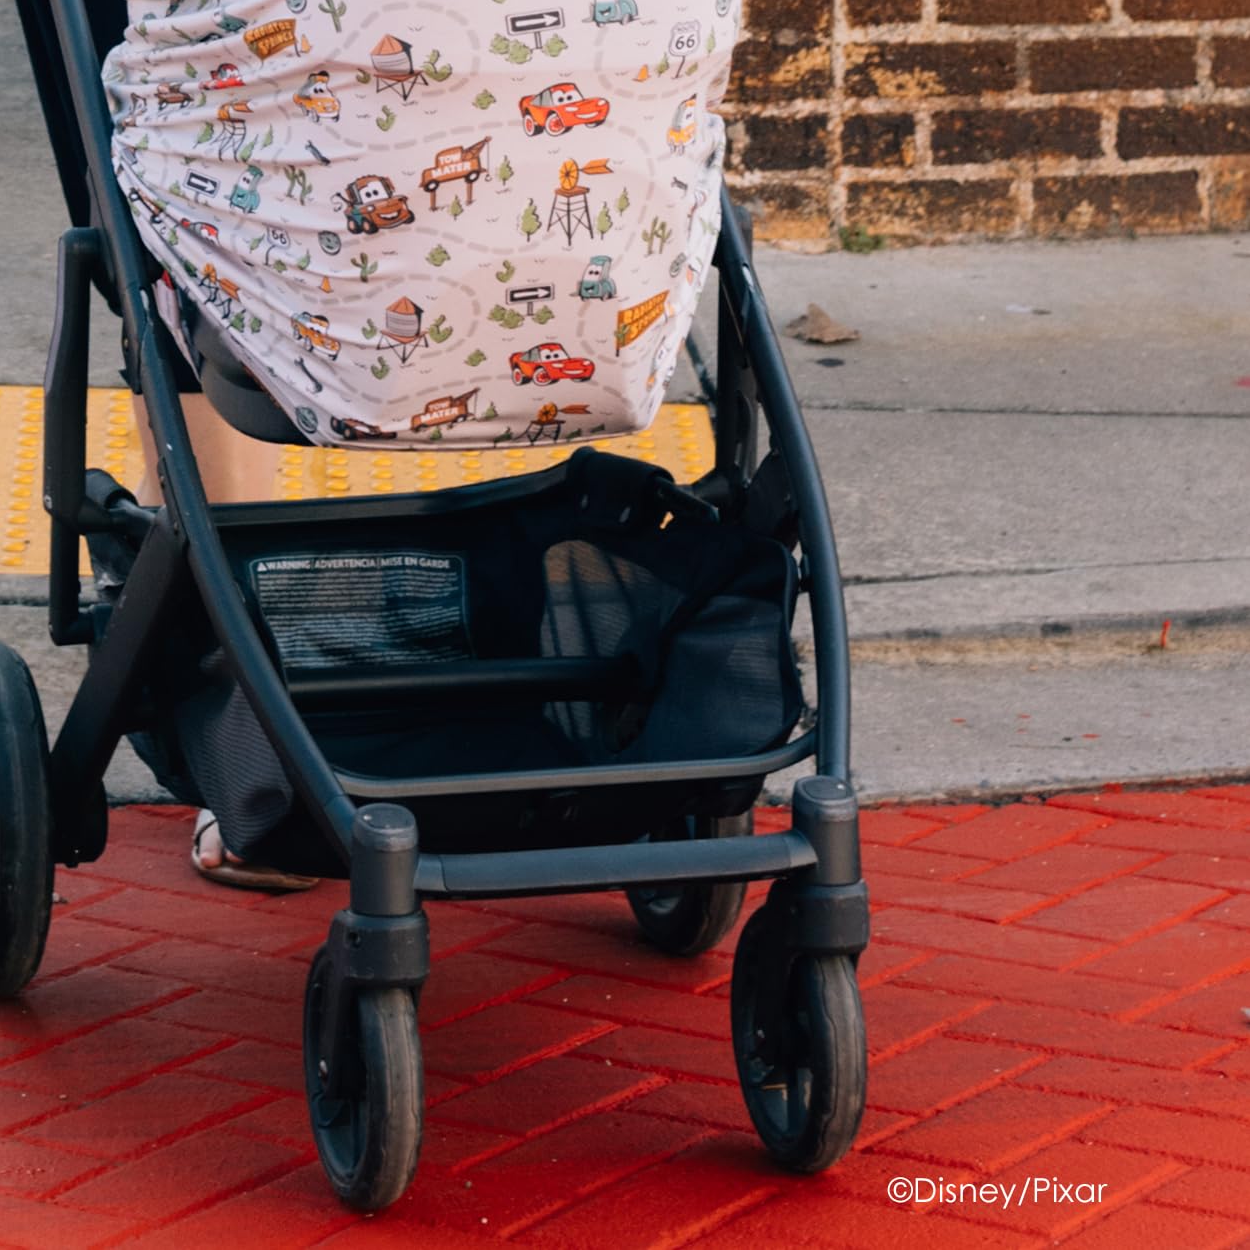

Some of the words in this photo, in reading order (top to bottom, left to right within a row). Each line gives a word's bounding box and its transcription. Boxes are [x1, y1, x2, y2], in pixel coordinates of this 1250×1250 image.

[675, 33, 695, 50] 66
[438, 152, 462, 165] TOW
[431, 161, 471, 178] MATER
[420, 407, 458, 423] MATER
[265, 560, 311, 570] WARNING
[315, 558, 376, 568] ADVERTENCIA
[381, 557, 403, 567] MISE
[405, 556, 418, 566] EN
[419, 558, 450, 569] GARDE
